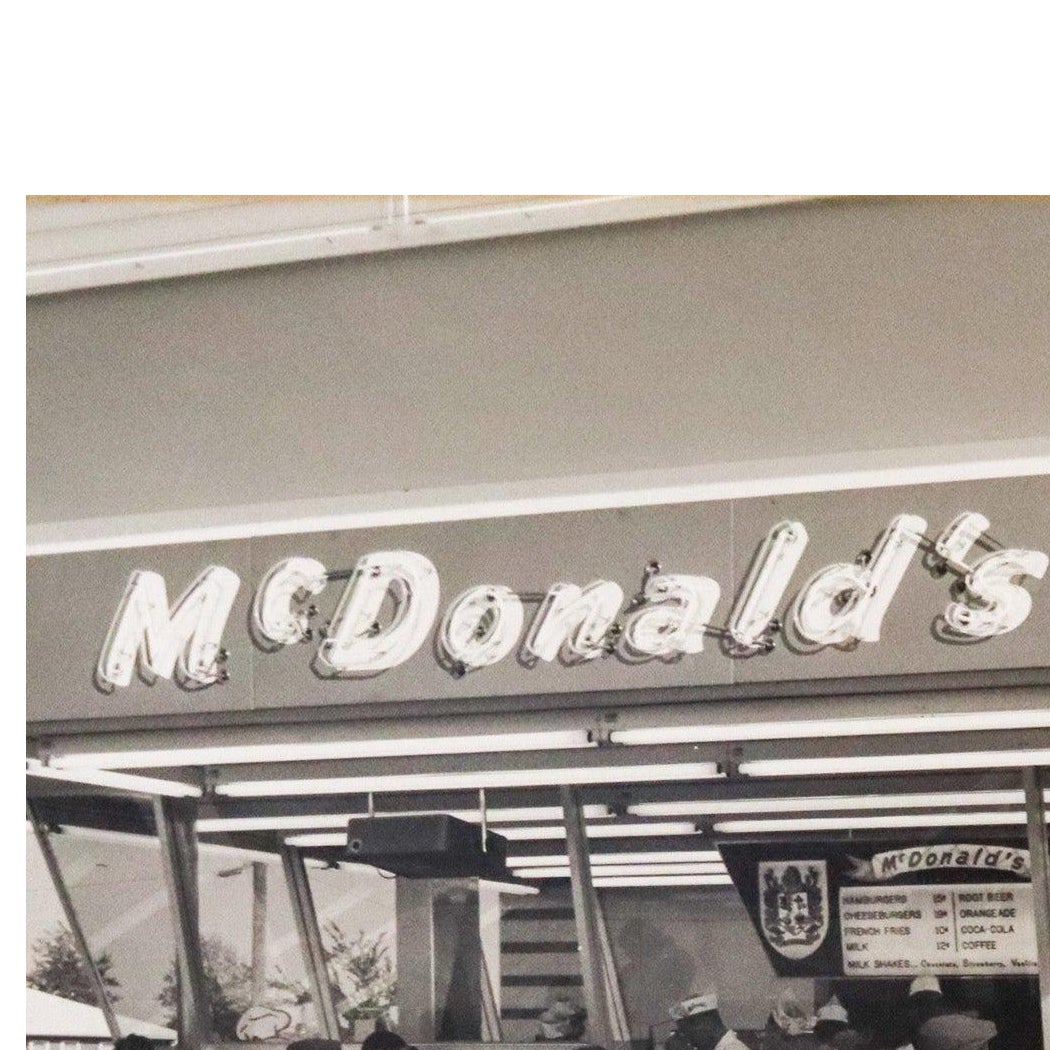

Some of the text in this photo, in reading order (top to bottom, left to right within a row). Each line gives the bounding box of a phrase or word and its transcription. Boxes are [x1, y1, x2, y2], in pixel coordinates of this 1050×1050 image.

[97, 511, 1049, 690] McDonald's
[881, 848, 1025, 873] McDonald's
[842, 909, 922, 920] CHEESEBURGERS
[844, 926, 881, 936] FRENCH
[884, 926, 911, 935] FRIES
[845, 943, 869, 952] MILK
[962, 941, 997, 950] COFFEE
[847, 959, 870, 968] MILK
